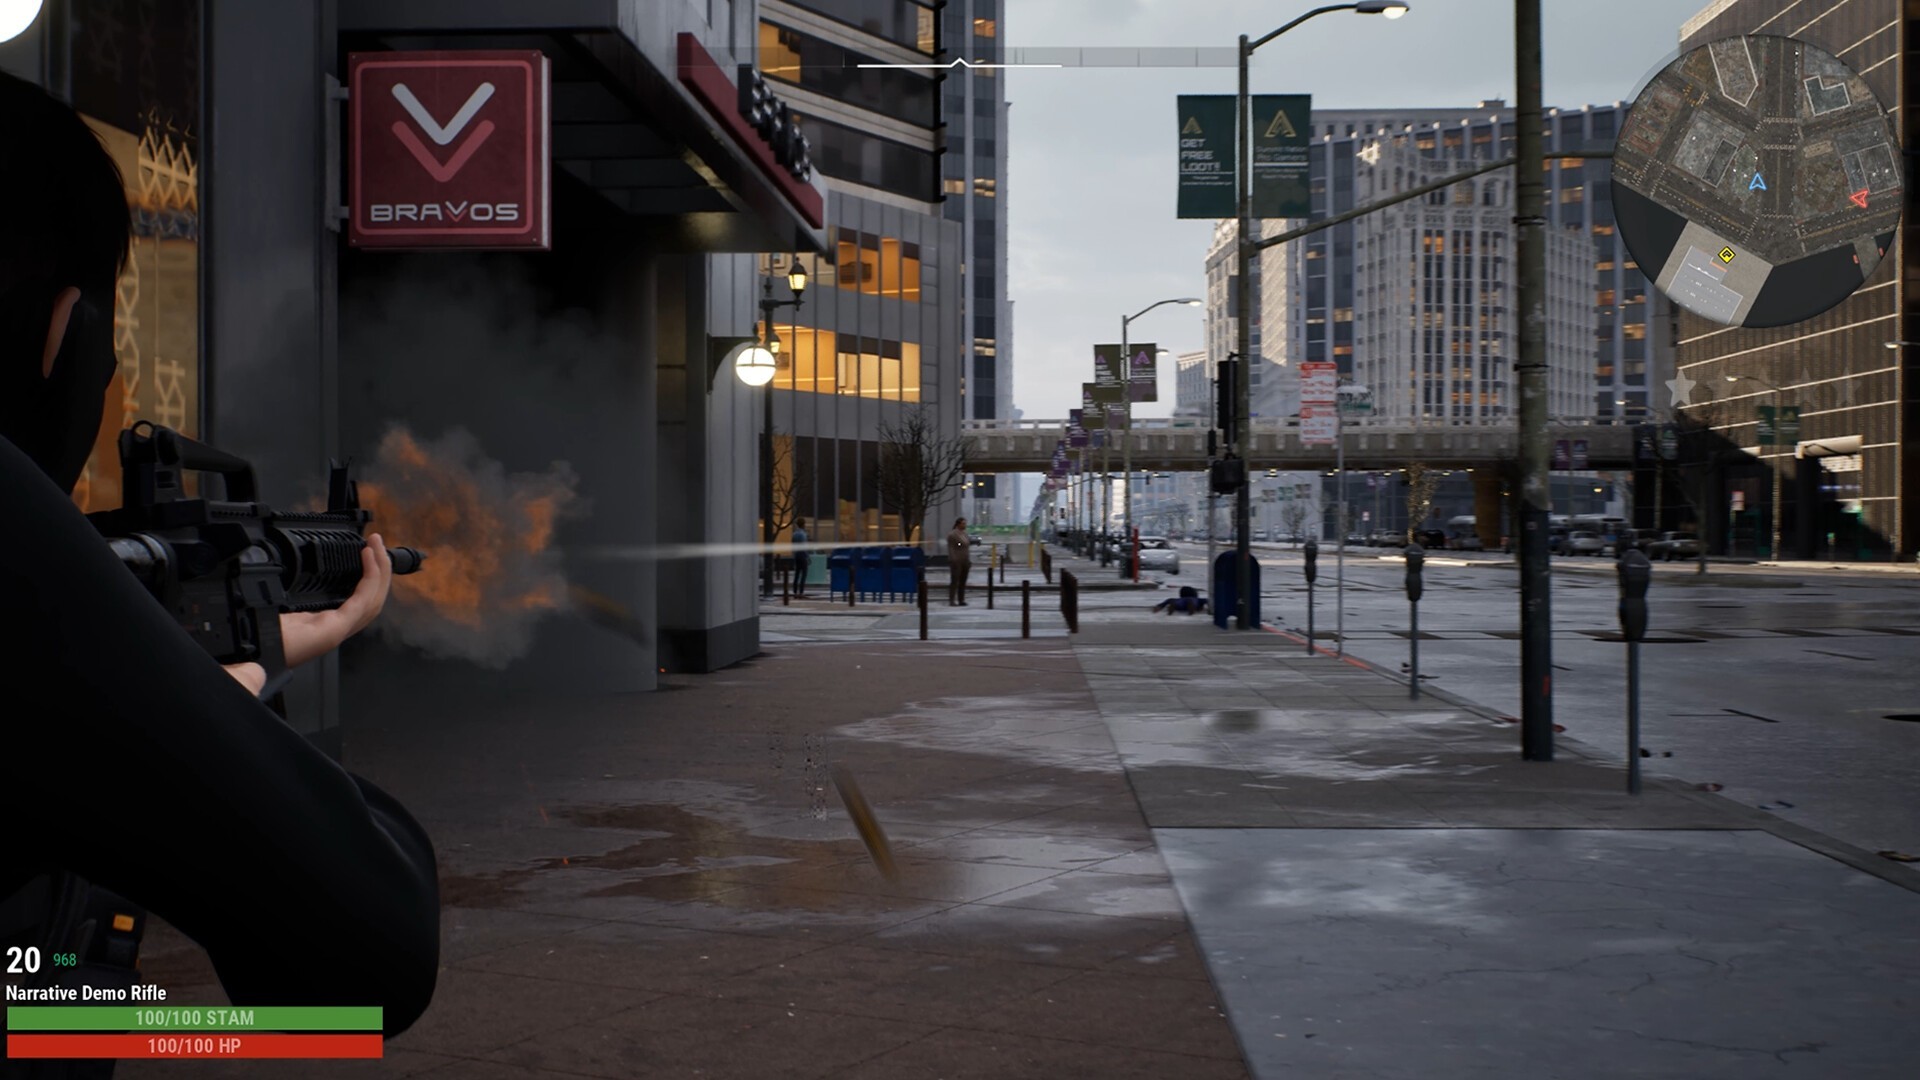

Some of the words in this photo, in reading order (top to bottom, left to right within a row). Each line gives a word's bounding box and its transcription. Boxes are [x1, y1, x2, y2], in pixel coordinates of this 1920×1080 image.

[1180, 138, 1206, 148] GET
[1181, 150, 1214, 160] FREE
[370, 201, 519, 222] BRAVOS
